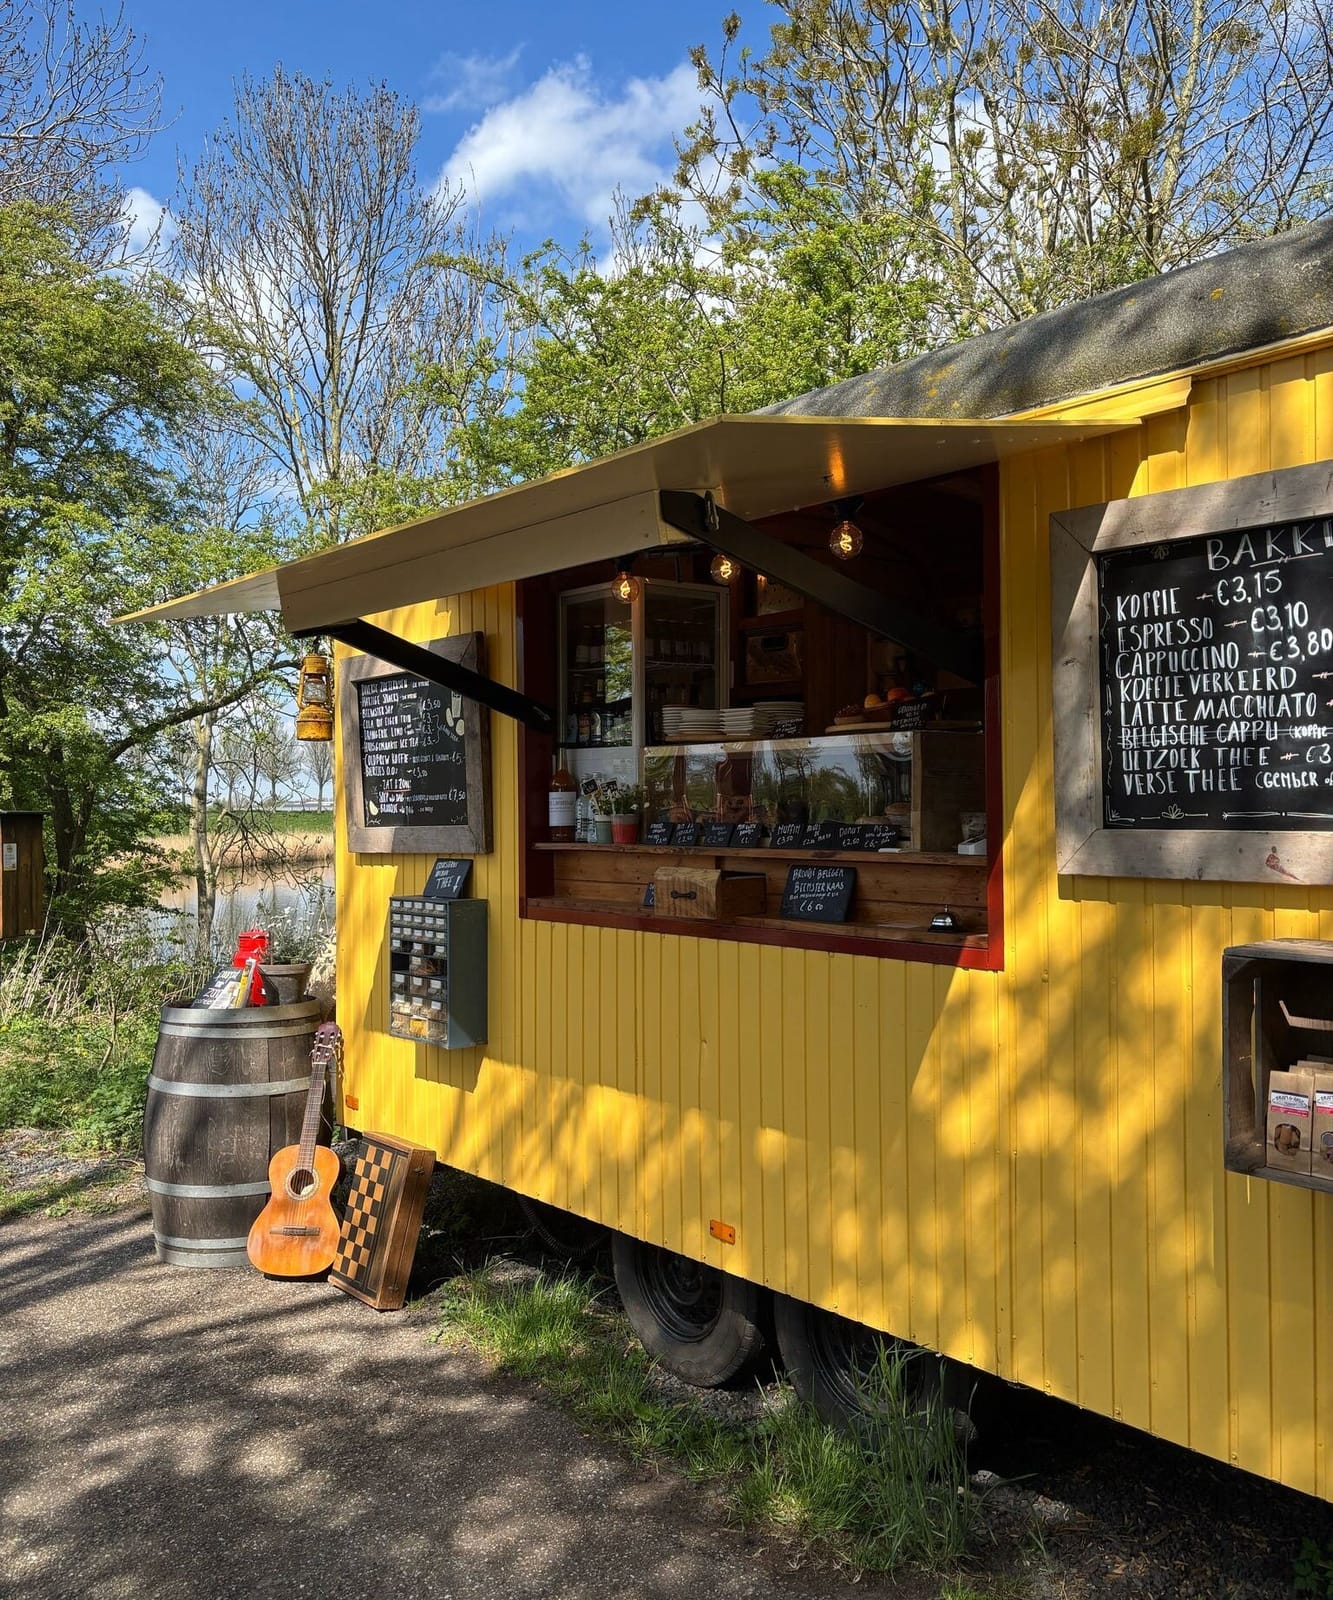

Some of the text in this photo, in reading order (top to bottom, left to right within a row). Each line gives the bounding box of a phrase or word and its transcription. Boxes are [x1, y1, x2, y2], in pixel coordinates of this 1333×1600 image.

[1116, 570, 1283, 622] KOFFIE €3,15
[1117, 617, 1213, 653] ESPRESSO
[1115, 628, 1333, 679] CAPPUCCINO €3,80
[1120, 666, 1297, 703] KOFFIE VERKEERD
[1120, 692, 1317, 727] LATTE MACCHIATO
[1121, 725, 1209, 750] BELGISCHE
[1216, 721, 1279, 744] CAPPU
[1122, 748, 1201, 771] UITZOEK
[1213, 746, 1271, 767] THEE
[1123, 771, 1178, 796] VERSE
[1184, 767, 1242, 793] THEE
[777, 825, 801, 835] MUFFIN
[839, 826, 862, 838] DONUT
